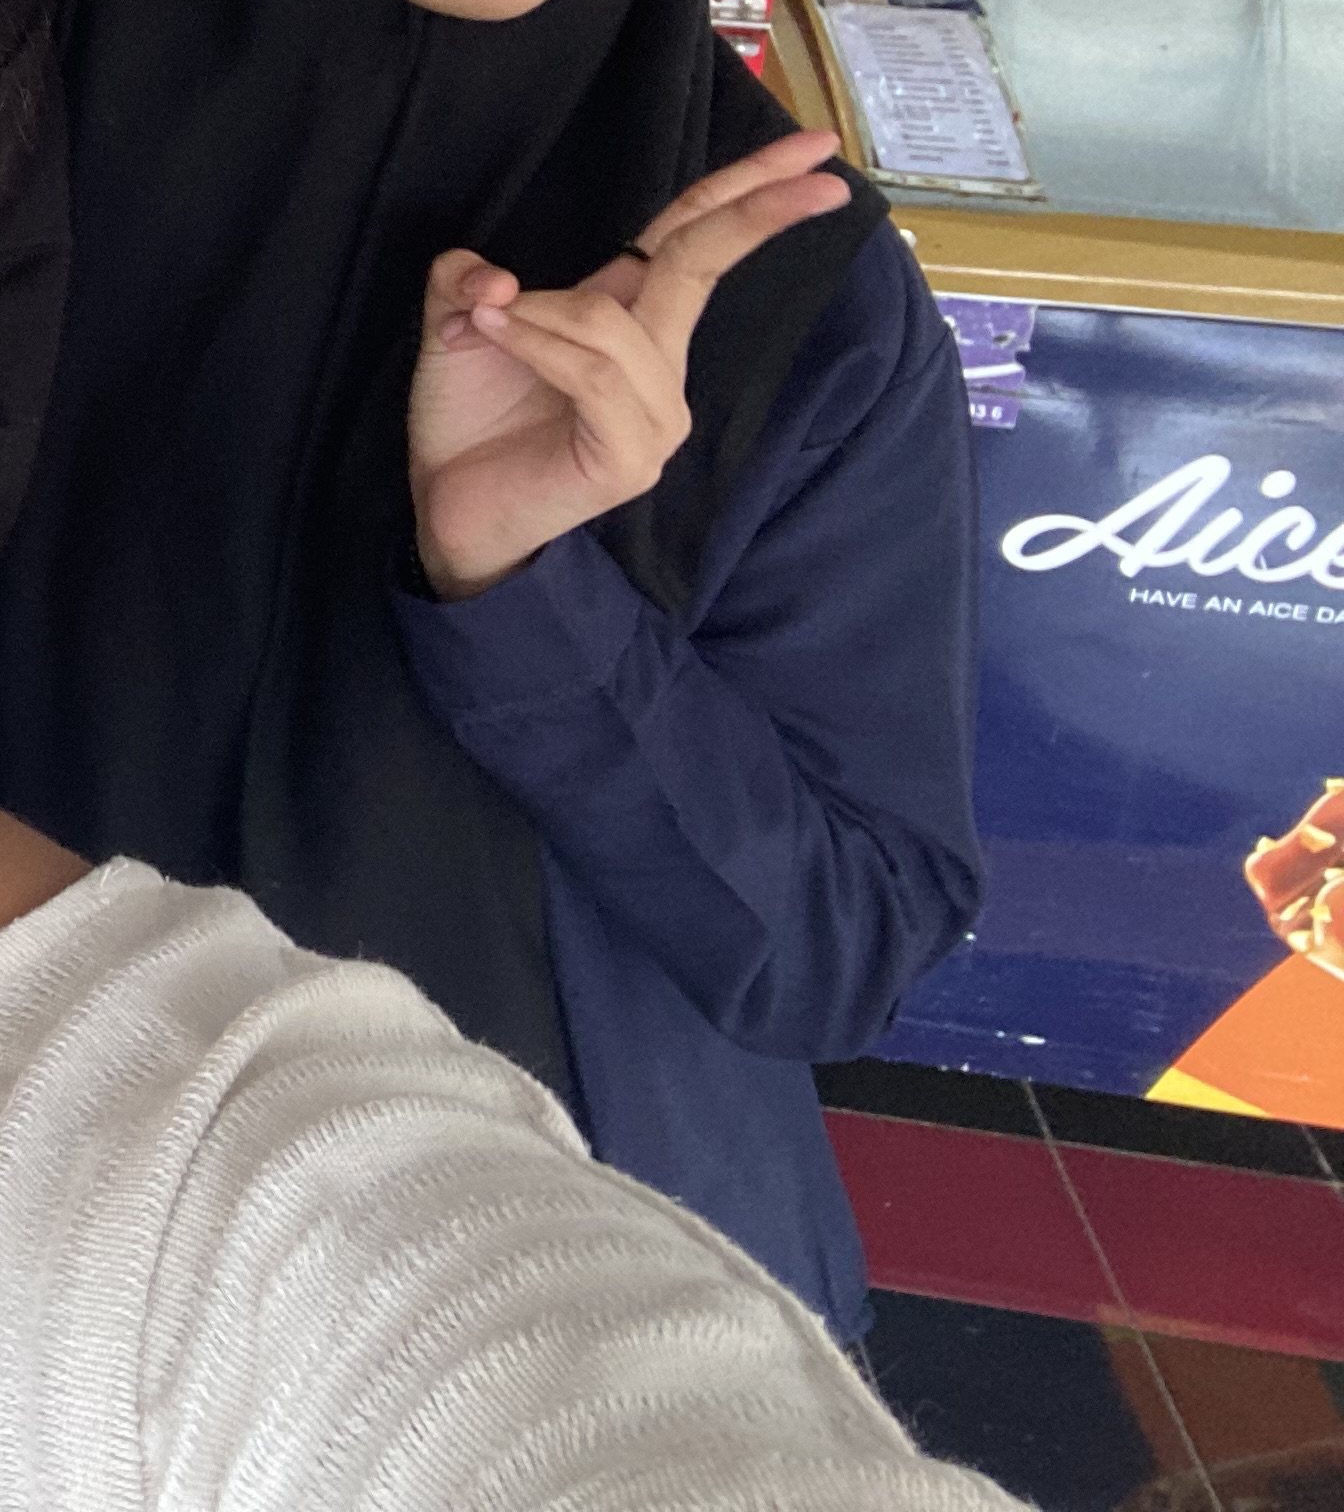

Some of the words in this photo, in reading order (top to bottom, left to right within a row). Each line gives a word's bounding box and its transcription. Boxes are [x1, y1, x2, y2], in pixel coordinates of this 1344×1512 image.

[1129, 587, 1199, 609] HAVE
[1204, 595, 1242, 615] AN
[1248, 599, 1310, 622] AICE
